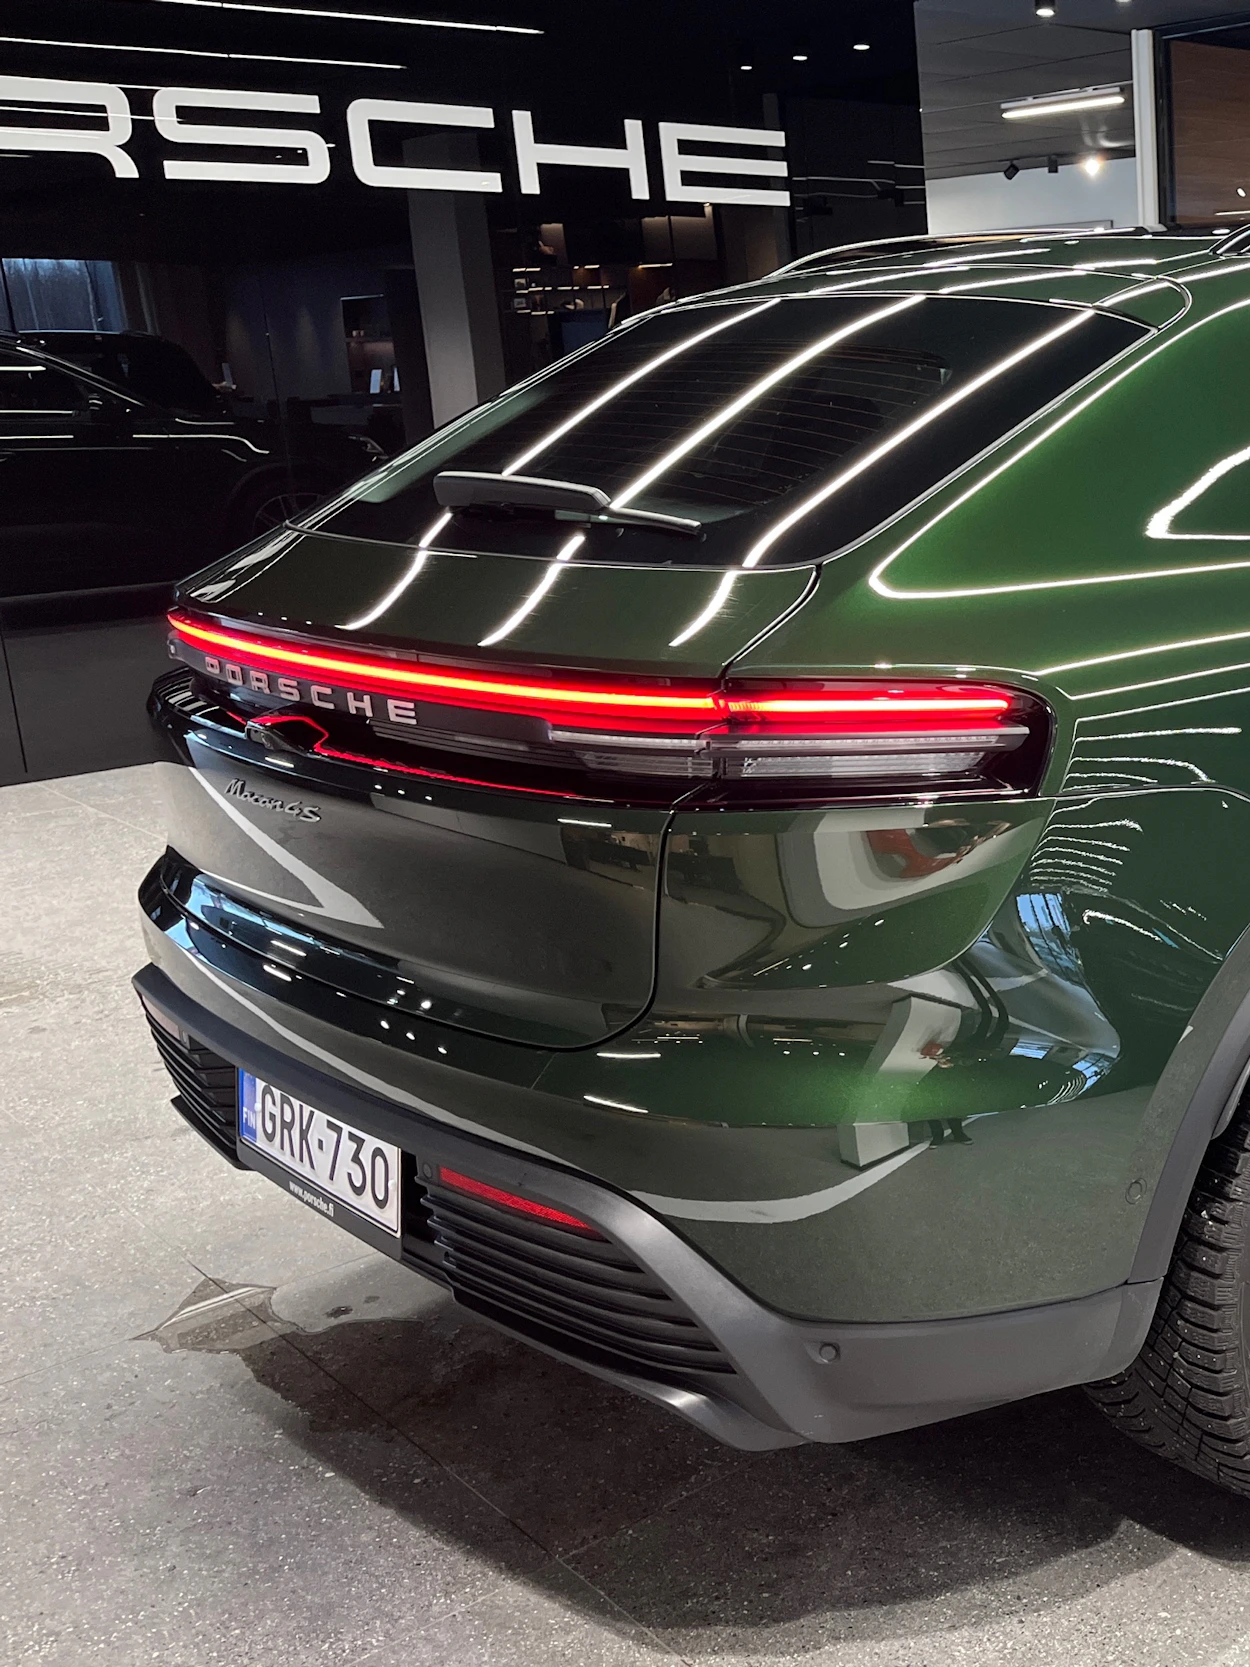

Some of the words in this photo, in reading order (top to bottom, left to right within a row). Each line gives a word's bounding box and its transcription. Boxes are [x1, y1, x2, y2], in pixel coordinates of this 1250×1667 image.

[205, 656, 418, 725] PORSCHE
[224, 779, 284, 812] Macan
[242, 1107, 256, 1130] FIN
[261, 1084, 389, 1210] GRK-730
